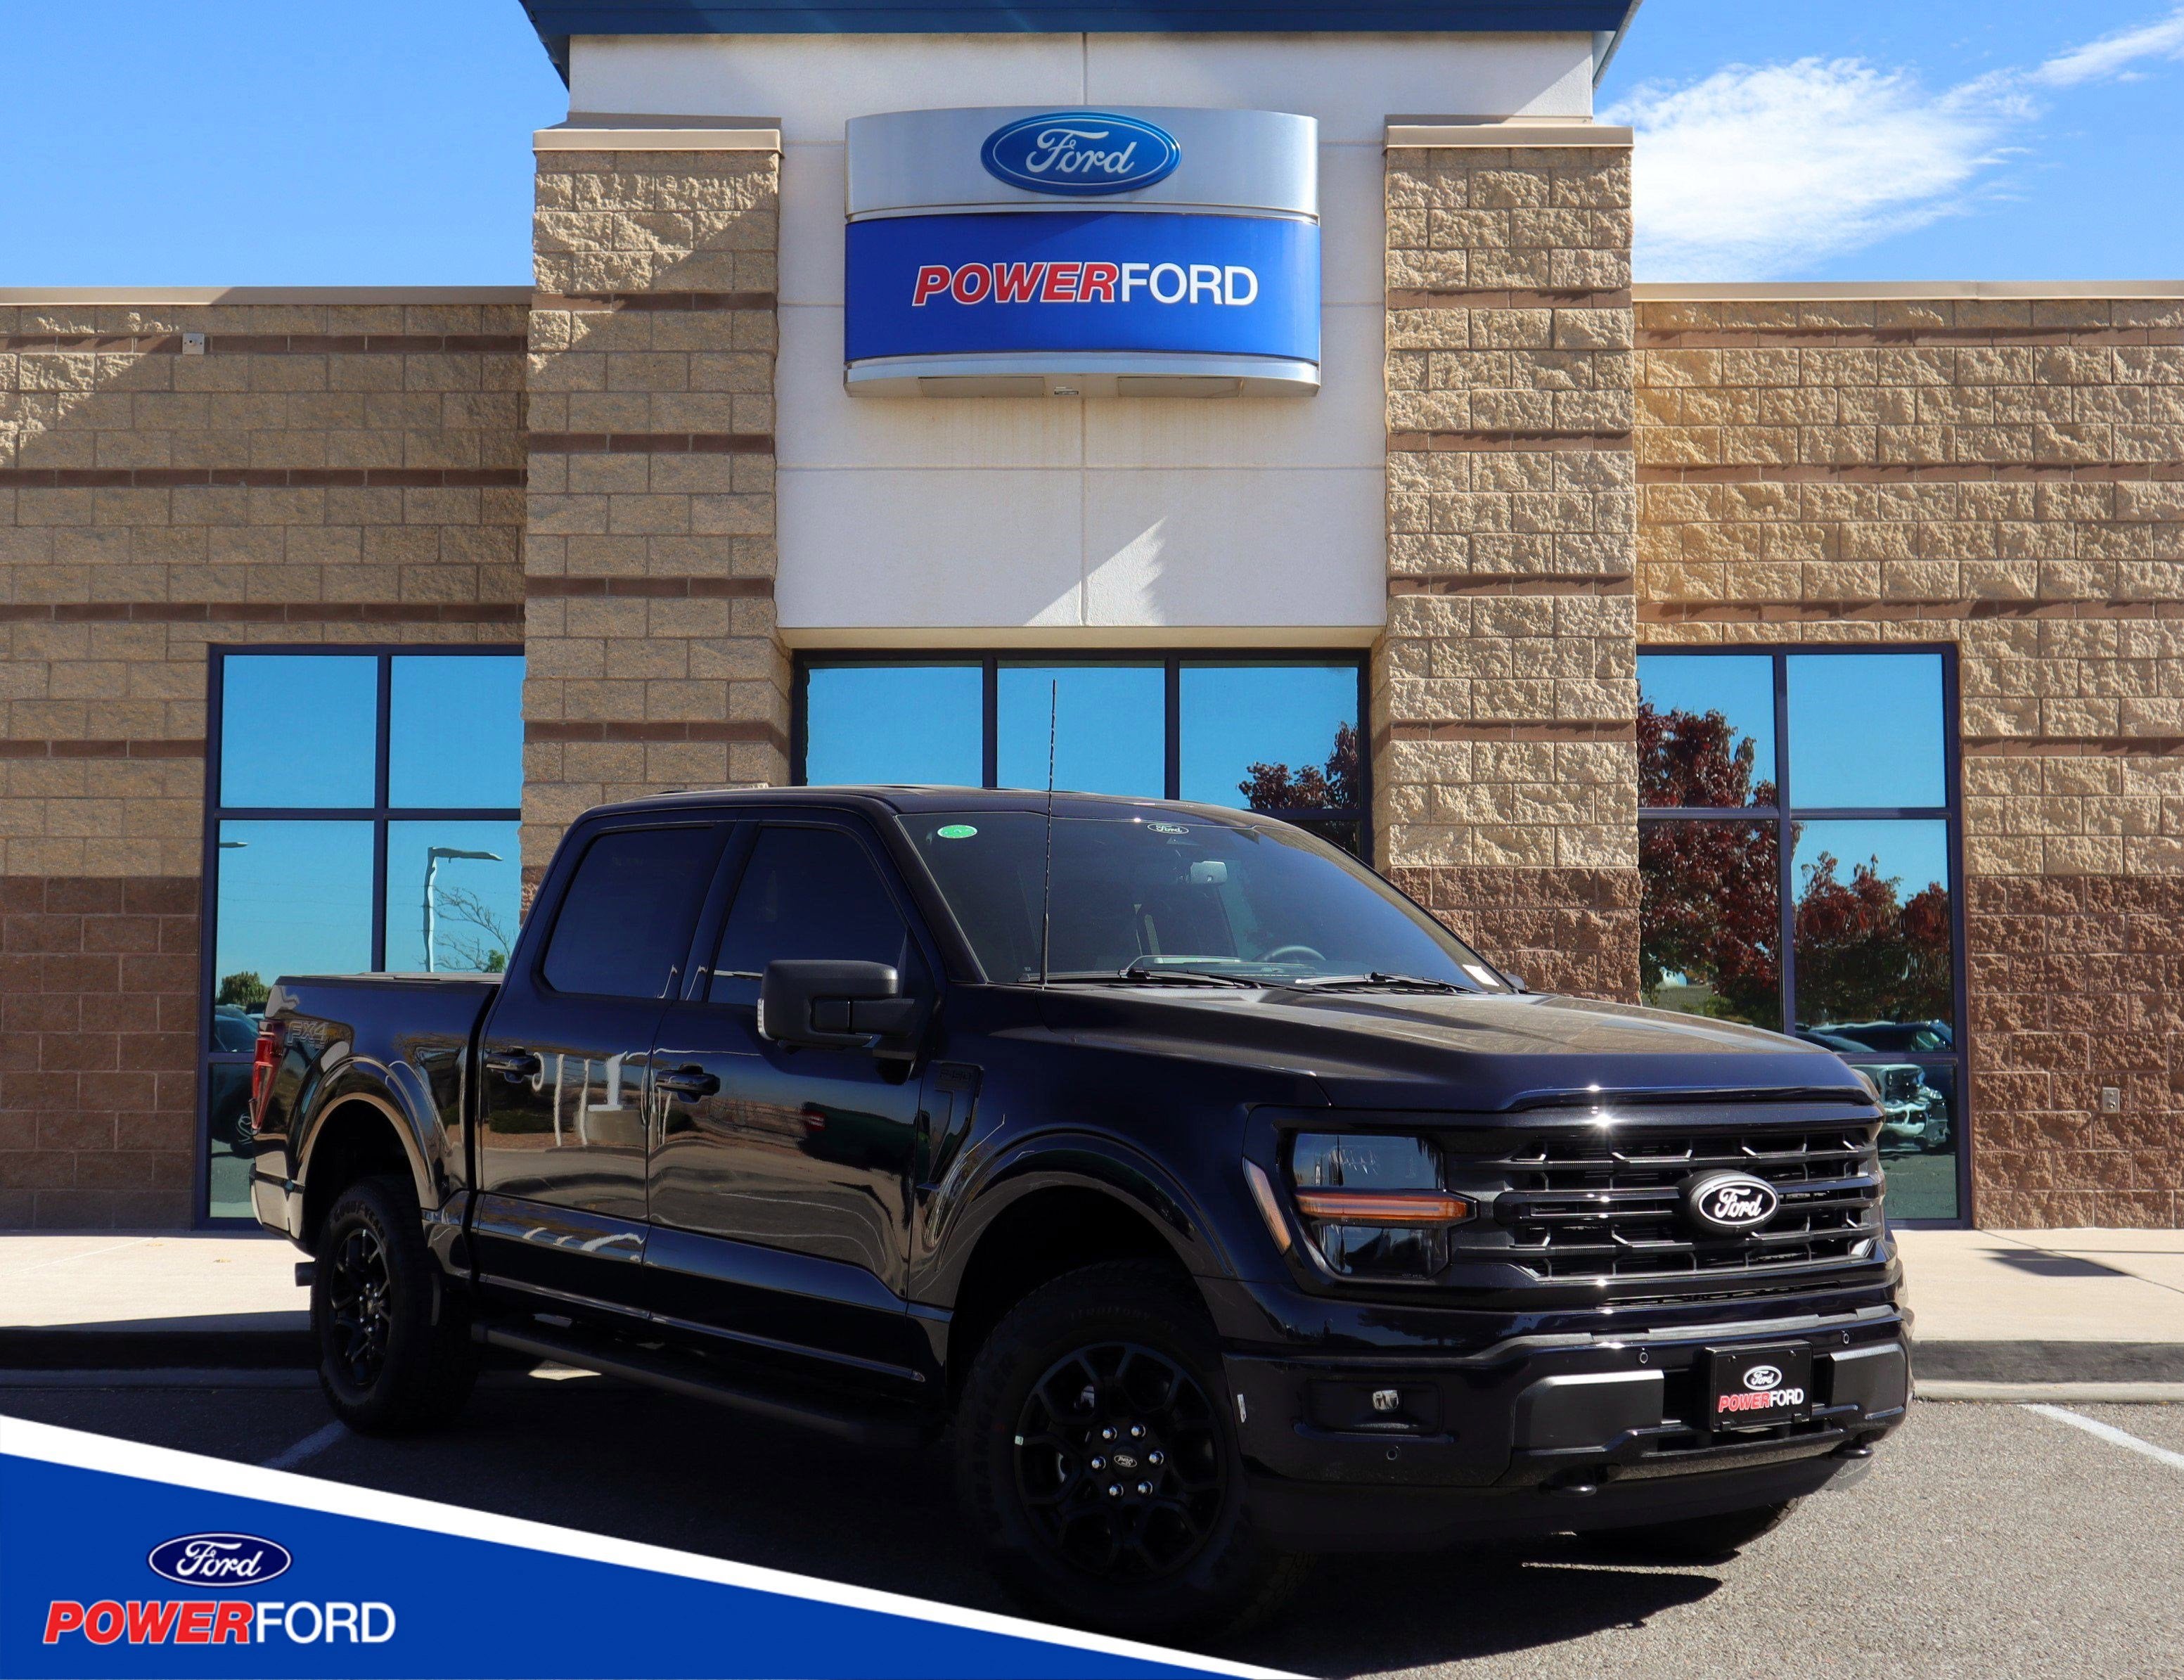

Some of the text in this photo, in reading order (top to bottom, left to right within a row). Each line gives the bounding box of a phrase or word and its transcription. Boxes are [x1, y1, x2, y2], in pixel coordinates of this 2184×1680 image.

[1026, 127, 1136, 174] Ford
[911, 261, 1259, 307] POWERFORD
[1156, 825, 1183, 833] Ford
[287, 1020, 329, 1046] FX4
[1714, 1188, 1763, 1218] Ford
[1751, 1371, 1774, 1385] Ford
[1718, 1387, 1804, 1413] POWERFORD
